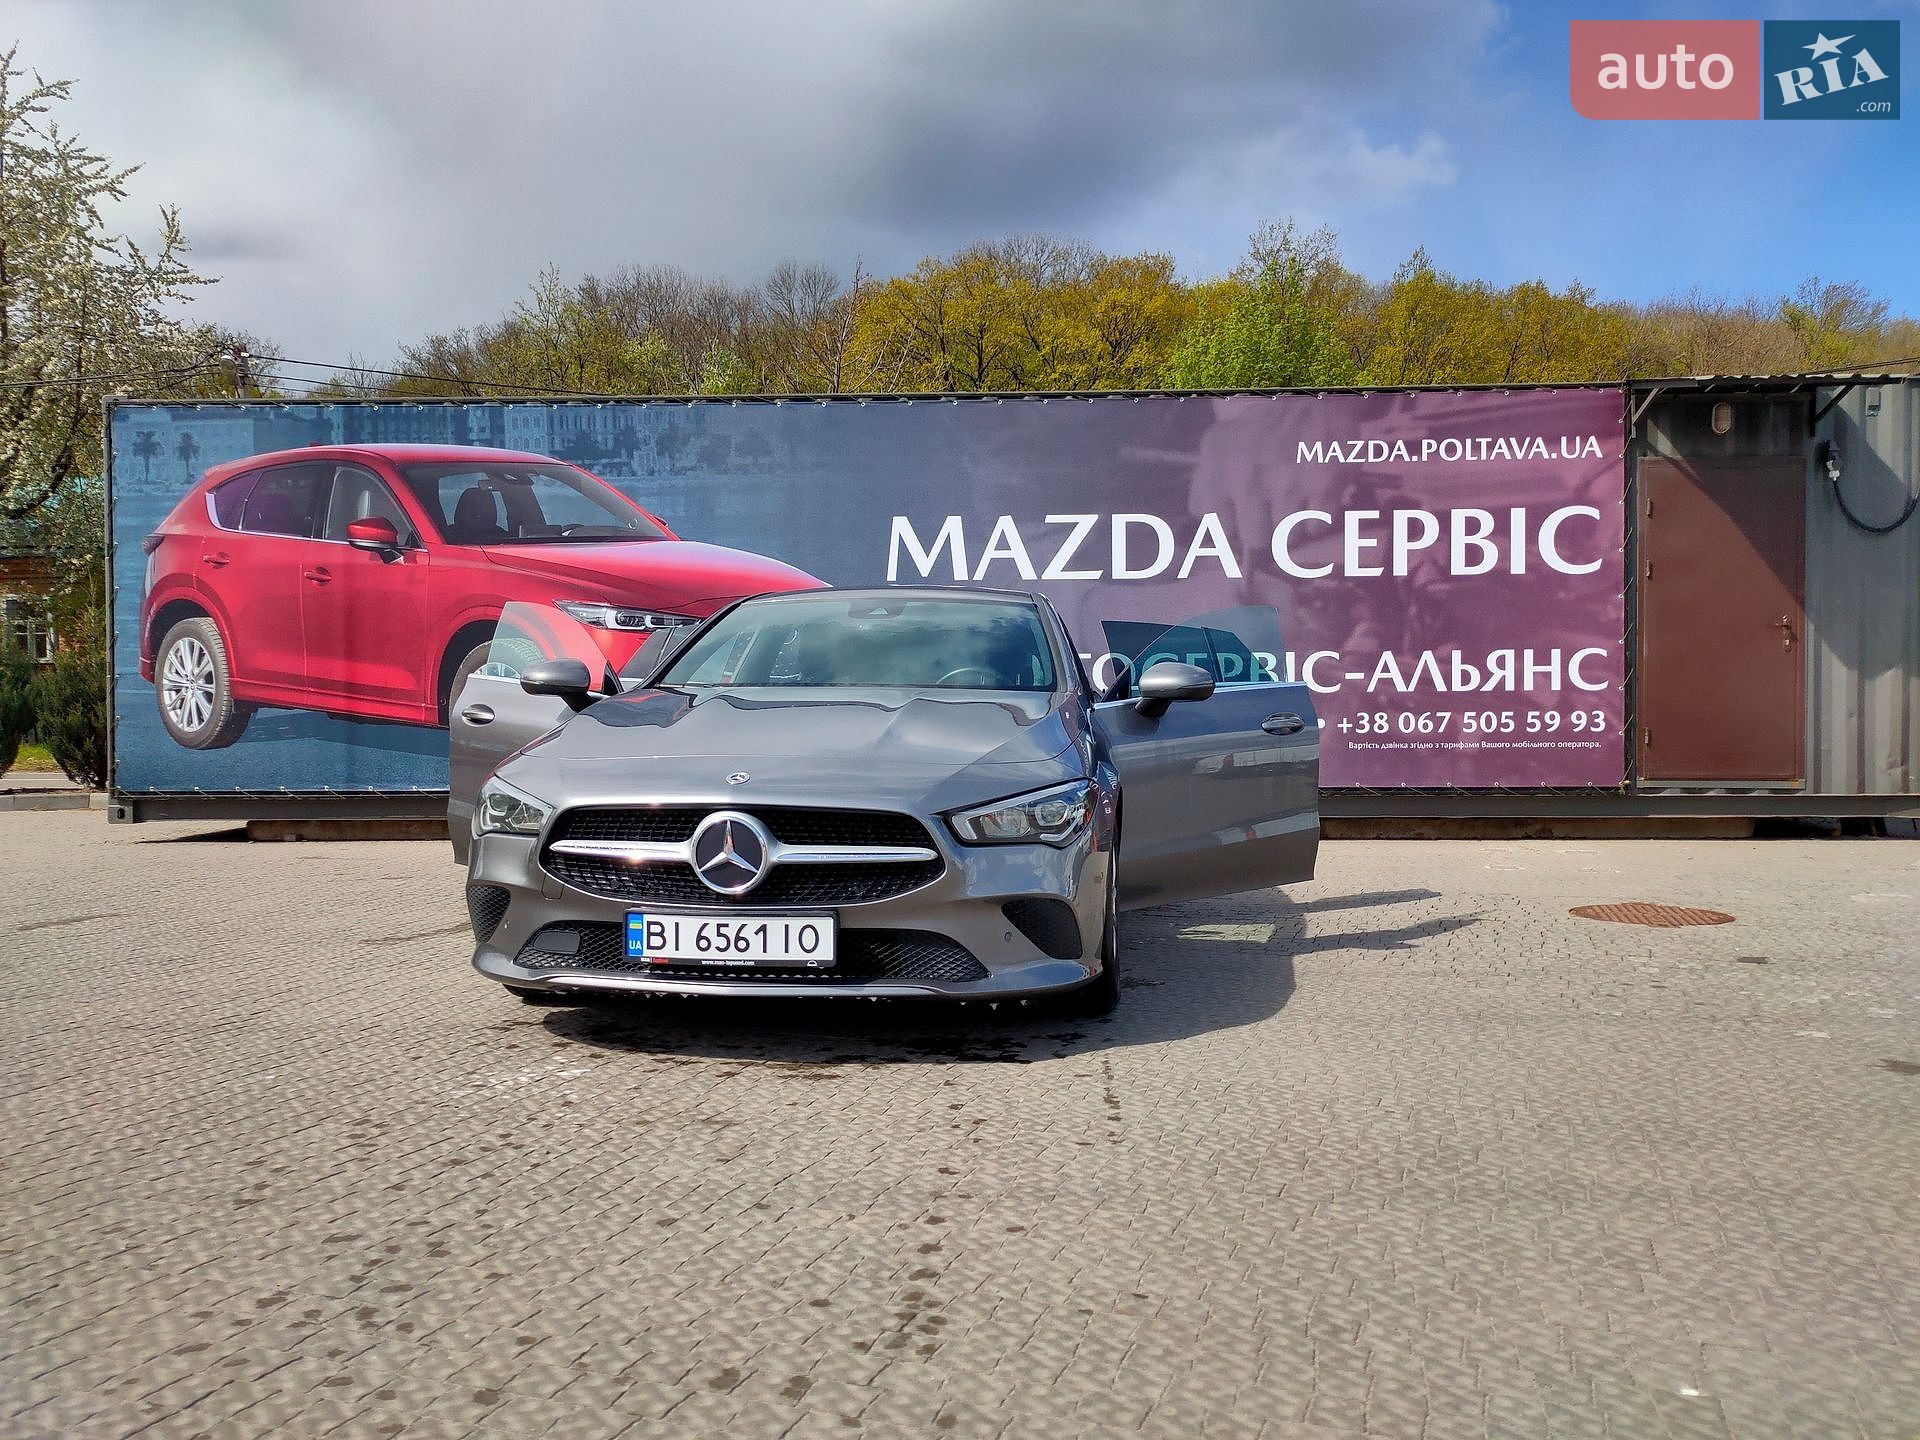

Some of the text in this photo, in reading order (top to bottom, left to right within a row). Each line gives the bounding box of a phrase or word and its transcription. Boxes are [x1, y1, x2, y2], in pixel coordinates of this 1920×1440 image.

[1296, 435, 1604, 465] MAZDA.POLTAVA.UA
[886, 505, 1604, 582] MAZDA СЕРВІС
[1079, 646, 1610, 695] ОРВІС-АЛЬЯНС
[1337, 710, 1606, 734] +38 067 505 59 93
[1348, 741, 1380, 751] Вартість
[1381, 741, 1409, 750] дзвінка
[1410, 741, 1434, 750] згідно
[1441, 740, 1480, 750] тарифами
[1481, 740, 1510, 749] Вашого
[1512, 740, 1556, 749] мобільного
[1557, 741, 1602, 750] оператора.
[629, 939, 642, 950] UA
